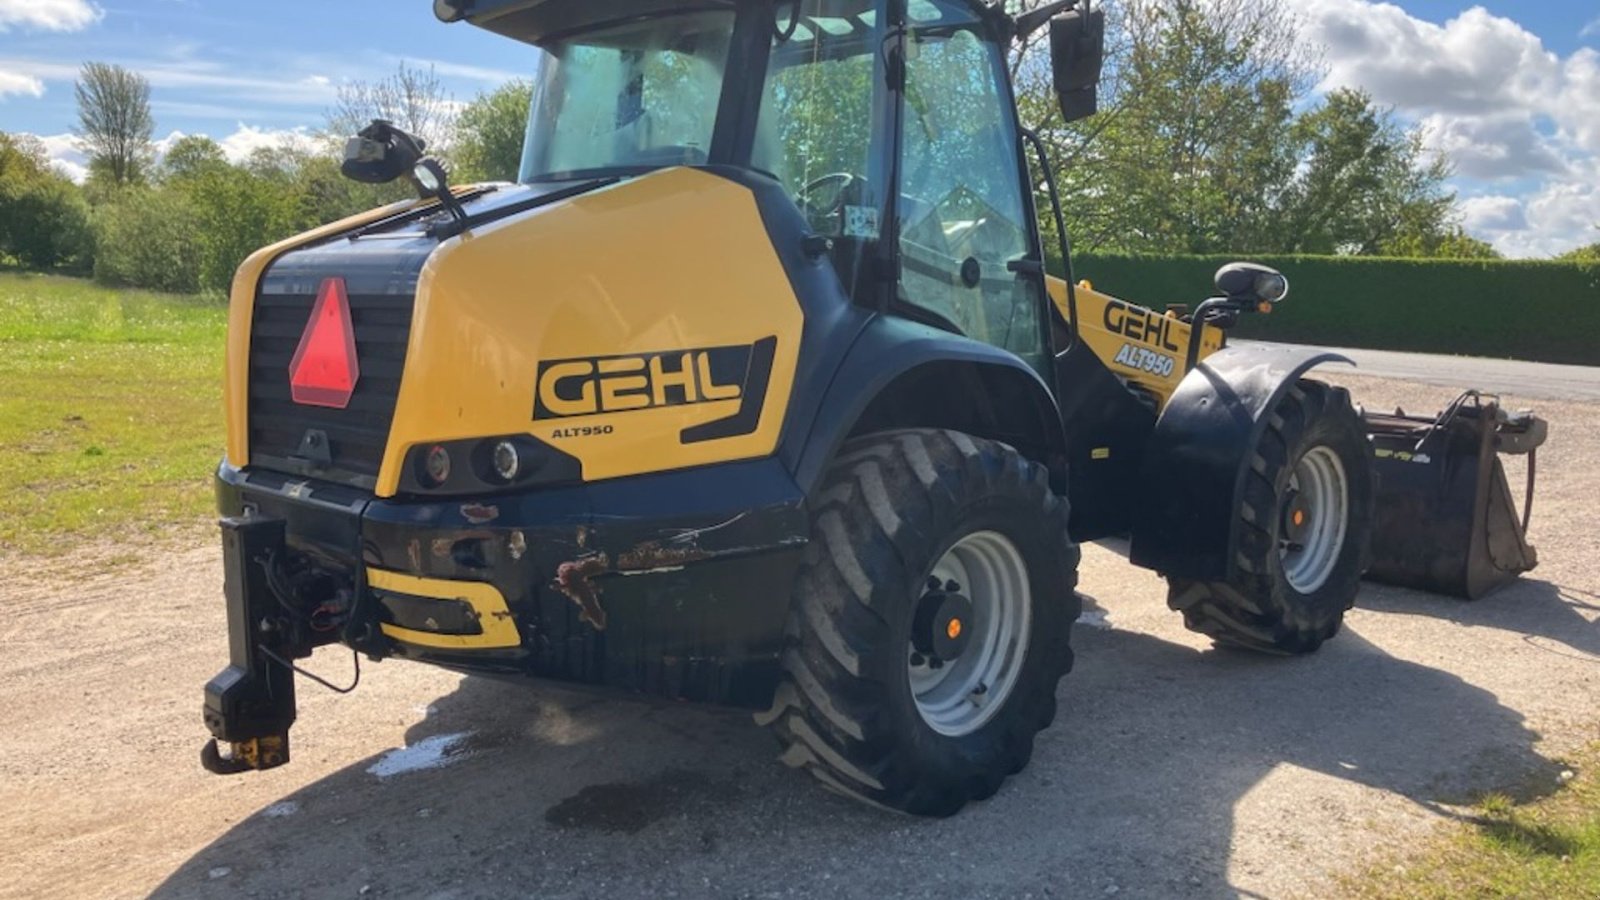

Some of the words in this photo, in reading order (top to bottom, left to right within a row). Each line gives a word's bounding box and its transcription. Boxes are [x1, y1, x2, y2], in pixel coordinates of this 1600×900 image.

[1103, 300, 1178, 352] GEHL
[1114, 343, 1174, 378] ALT950
[538, 352, 741, 415] GEHL
[551, 424, 614, 439] ALT950
